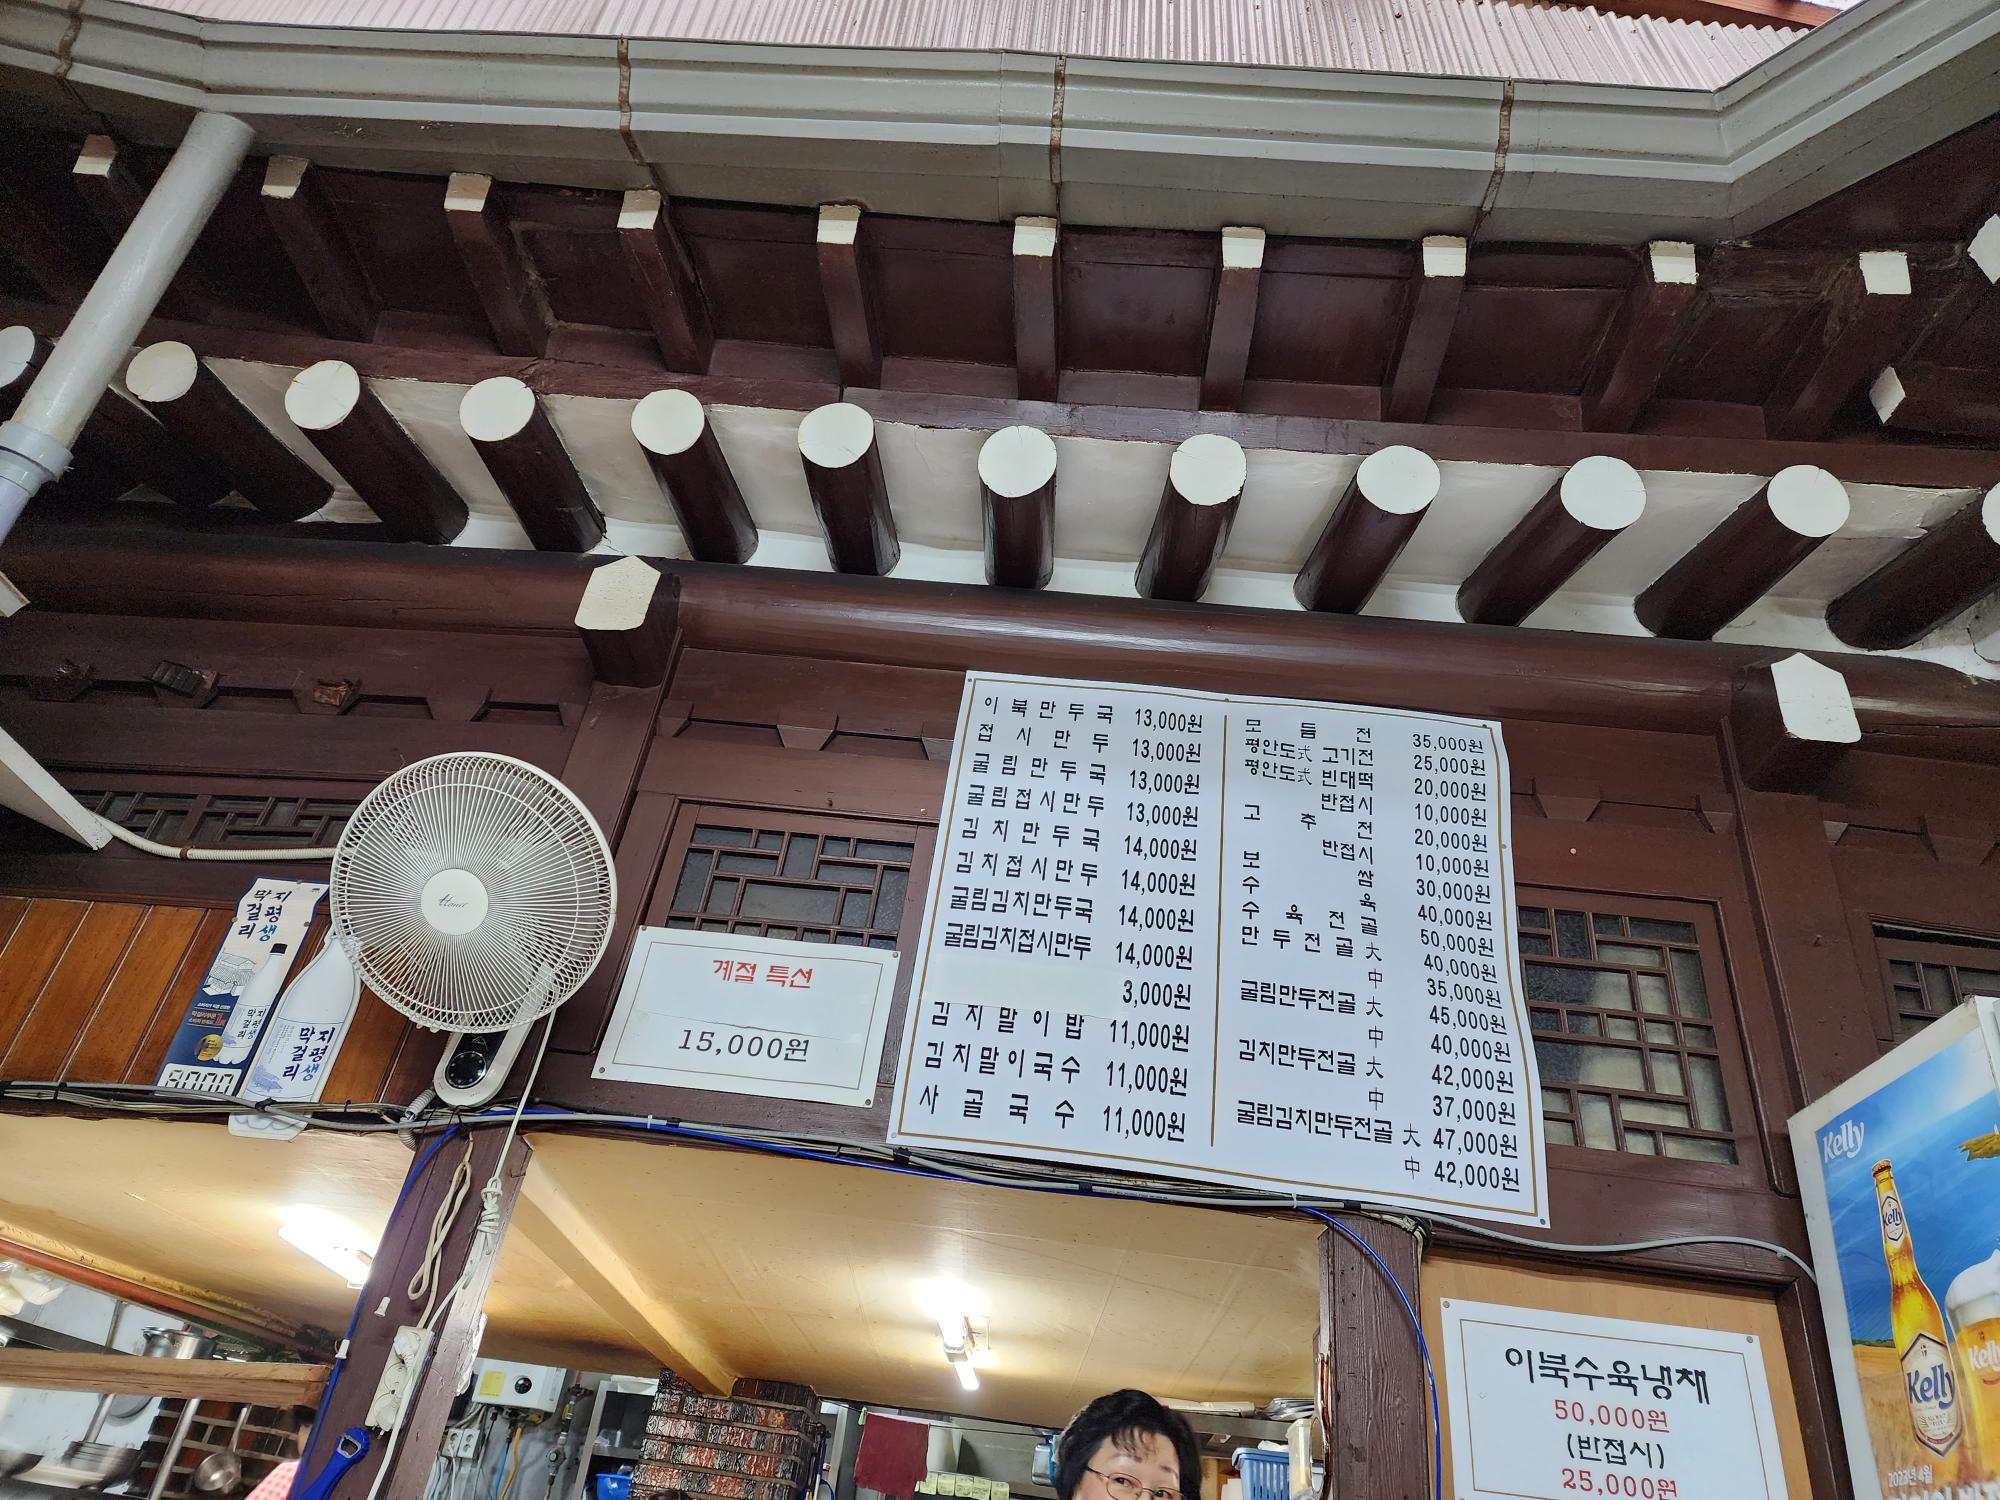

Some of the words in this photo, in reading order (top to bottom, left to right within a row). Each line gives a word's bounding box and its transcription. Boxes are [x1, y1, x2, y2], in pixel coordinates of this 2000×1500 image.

[1135, 708, 1203, 734] 13,000원
[1131, 738, 1201, 764] 13,000원
[1412, 733, 1484, 754] 35,000원
[1322, 746, 1374, 767] 고기전
[1413, 754, 1486, 777] 25,000원
[1129, 769, 1200, 795] 13,000원
[1322, 769, 1374, 791] 빈대떡
[1414, 778, 1487, 802] 20,000원
[1127, 802, 1199, 828] 13,000원
[1321, 793, 1373, 816] 반접시
[1414, 803, 1487, 828] 10,000원
[1124, 834, 1197, 861] 14,000원
[1414, 828, 1488, 853] 20,000원
[1322, 839, 1374, 865] 반접시
[1416, 853, 1490, 879] 10,000원
[1121, 868, 1196, 897] 14,000원
[1416, 878, 1491, 905] 30,000원
[950, 885, 1093, 923] 굴림김치만두국
[1118, 904, 1194, 932] 14,000원
[1417, 904, 1493, 932] 40,000원
[1115, 941, 1193, 971] 14,000원
[1420, 928, 1495, 958] 50,000원
[712, 959, 758, 985] 계절
[766, 964, 814, 990] 특선
[1365, 942, 1383, 962] 大
[1423, 953, 1498, 984] 40,000원
[1122, 979, 1192, 1011] 3,000원
[1368, 968, 1383, 990] 中
[1426, 978, 1503, 1009] 35,000원
[1240, 979, 1357, 1015] 굴림만두전골
[1365, 995, 1384, 1018] 大
[1429, 1005, 1508, 1036] 45,000원
[678, 1028, 810, 1063] 15,000원
[1110, 1019, 1190, 1053] 11,000원
[1368, 1025, 1384, 1049] 中
[1430, 1033, 1512, 1064] 40,000원
[1107, 1060, 1188, 1097] 11,000원
[1238, 1038, 1356, 1076] 김치만두전골
[1365, 1056, 1385, 1079] 大
[1431, 1063, 1514, 1094] 42,000원
[1103, 1105, 1186, 1143] 11,000원
[1368, 1087, 1384, 1112] 中
[1432, 1094, 1517, 1126] 37,000원
[1236, 1099, 1393, 1145] 굴림김치만두전골
[1402, 1123, 1422, 1148] 大
[1433, 1127, 1519, 1159] 47,000원
[1822, 1119, 1865, 1163] Kelly
[1404, 1155, 1421, 1181] 中
[1434, 1160, 1520, 1193] 42,000원
[1505, 1347, 1711, 1406] 이북수육냉채
[1906, 1362, 1956, 1410] Kelly
[1554, 1398, 1671, 1434] 50,000원
[1566, 1432, 1666, 1470] (반접시)
[1561, 1467, 1678, 1500] 25,000원
